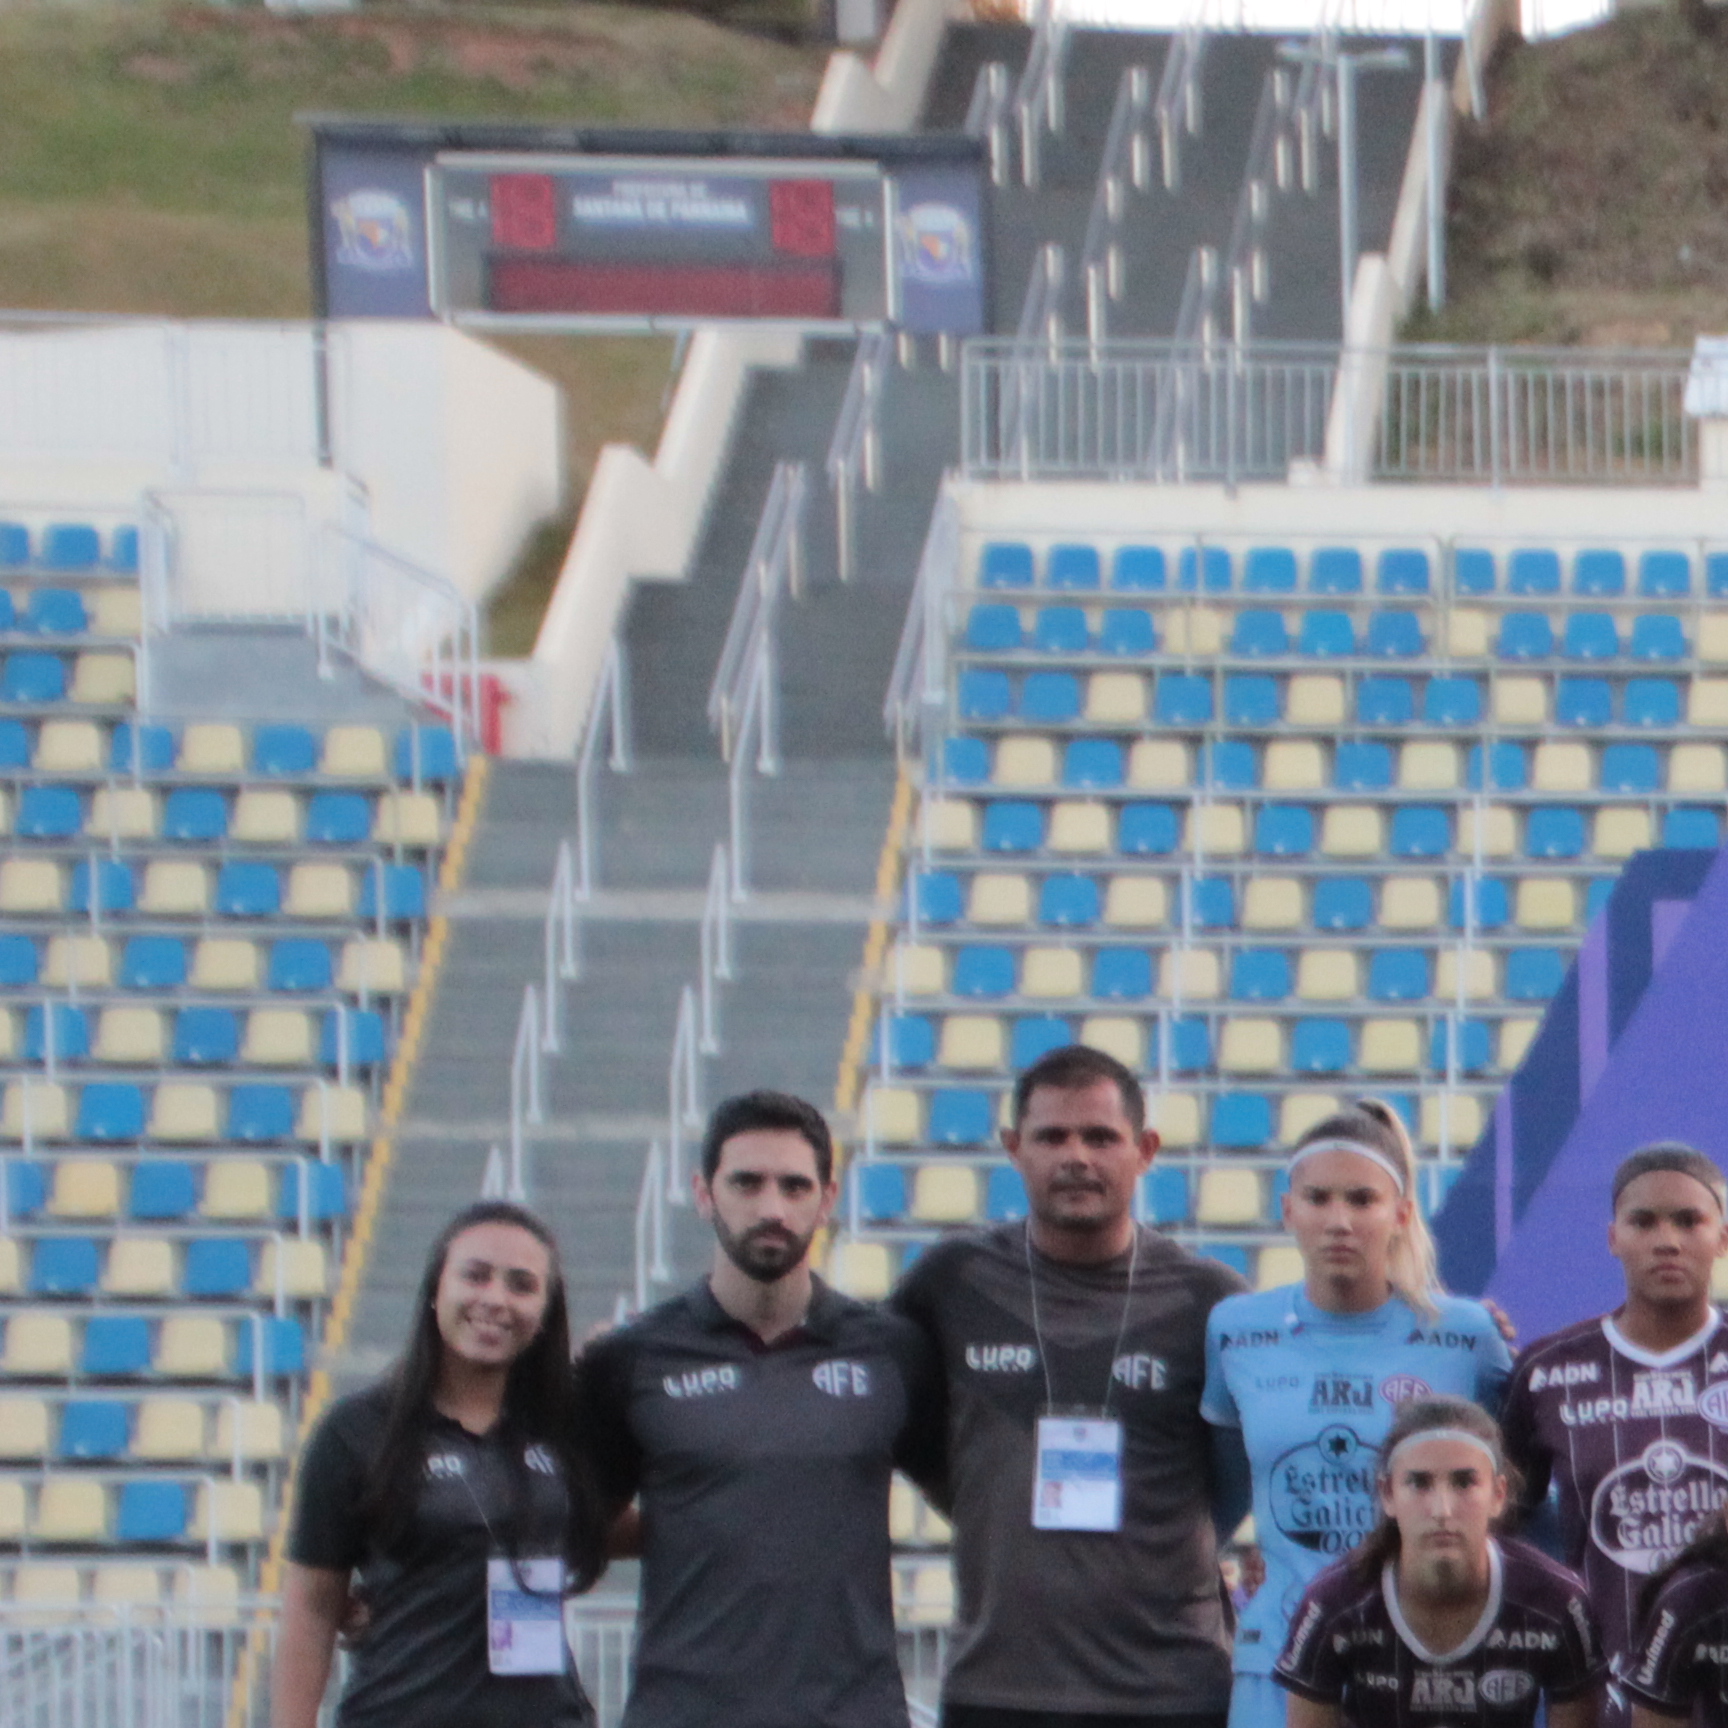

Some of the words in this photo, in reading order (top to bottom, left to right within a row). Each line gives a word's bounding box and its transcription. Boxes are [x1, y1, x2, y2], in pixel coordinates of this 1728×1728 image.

[1427, 1330, 1476, 1351] ADN
[1548, 1363, 1597, 1386] ADN
[1632, 1379, 1697, 1411] ARJ
[1560, 1399, 1627, 1425] LUPO
[1508, 1632, 1557, 1650] ADN
